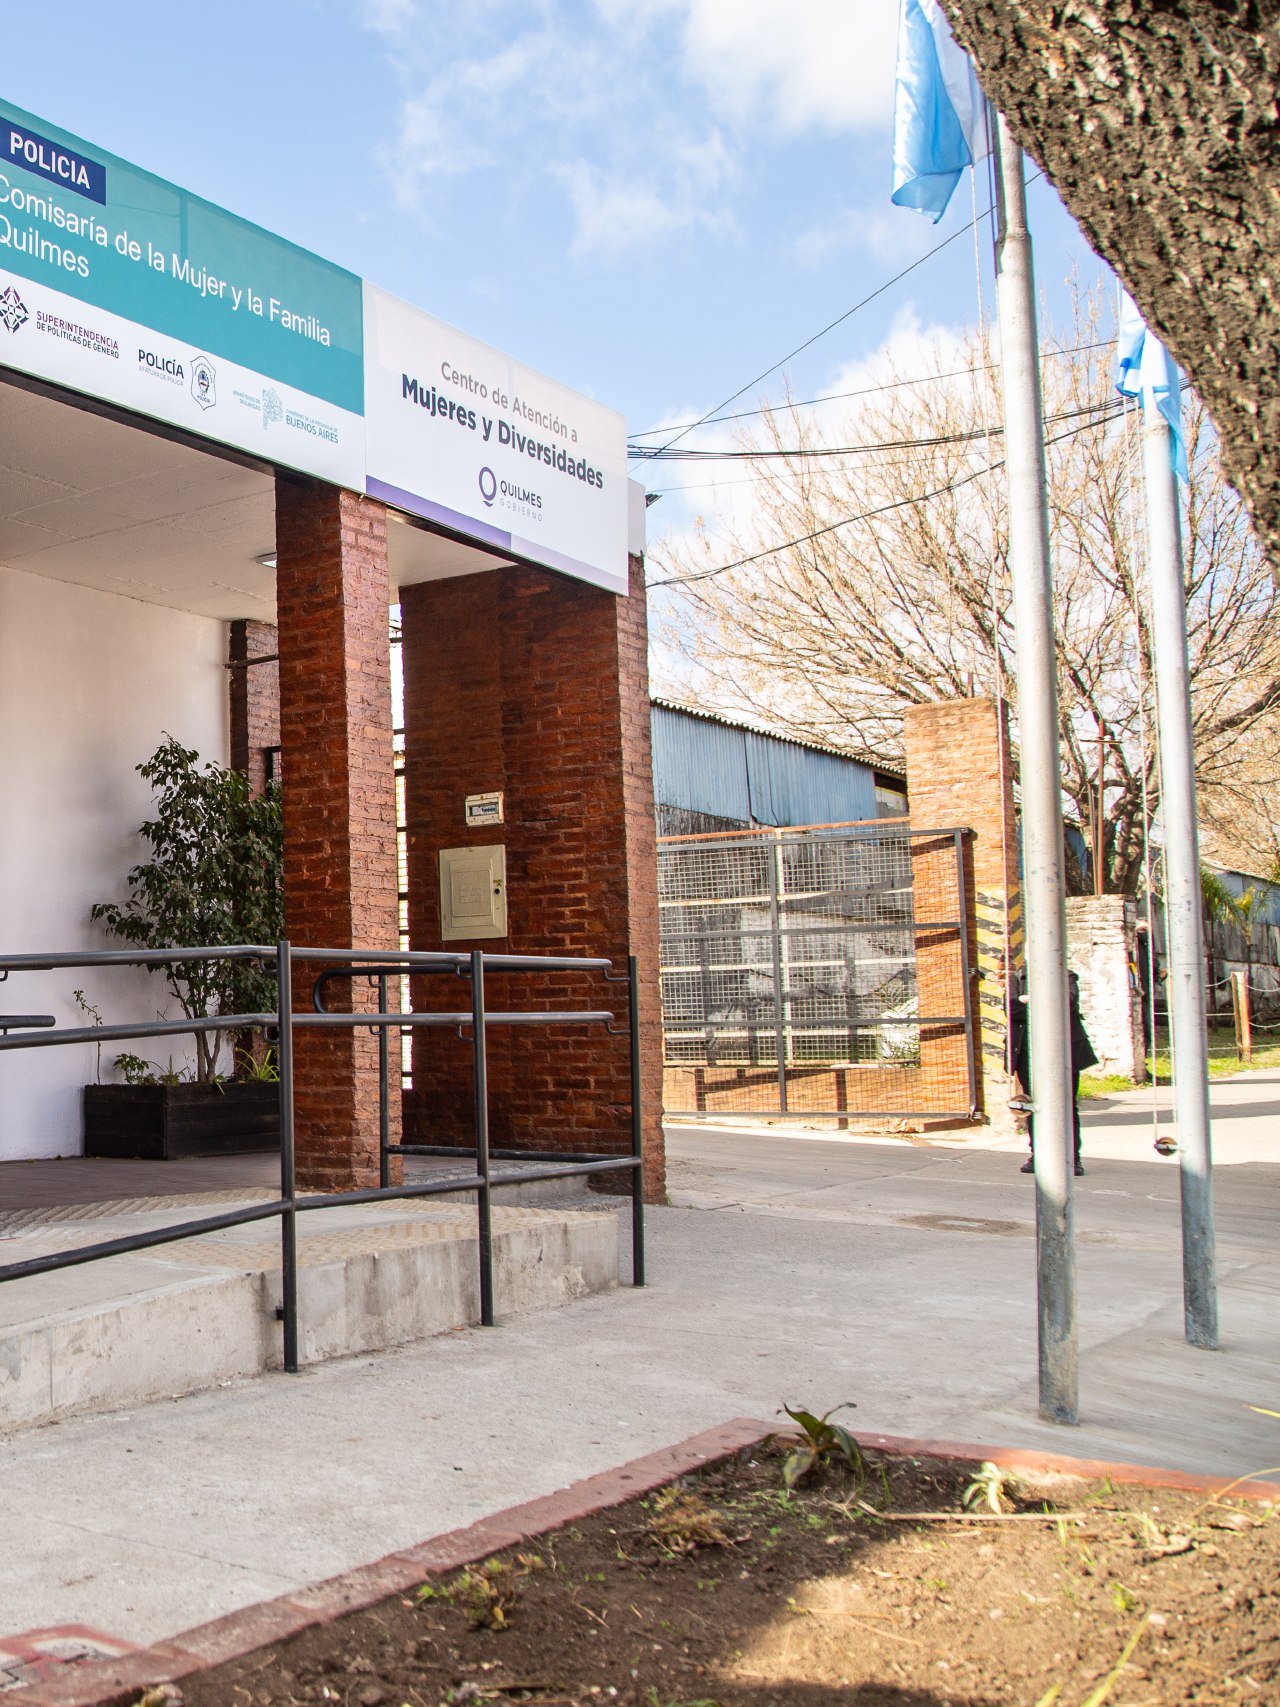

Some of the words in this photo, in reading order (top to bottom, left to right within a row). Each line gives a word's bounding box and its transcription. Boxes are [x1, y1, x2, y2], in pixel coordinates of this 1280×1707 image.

[10, 131, 91, 190] POLICIA
[114, 231, 141, 262] de
[148, 242, 165, 273] la
[172, 253, 226, 298] Mujer
[231, 285, 242, 311] y
[247, 288, 263, 317] la
[269, 297, 331, 347] Familia
[36, 310, 119, 350] SUPERINTENDENCIA
[36, 321, 46, 332] DE
[82, 338, 92, 349] DE
[138, 349, 185, 379] POLICÍA
[440, 361, 488, 399] Centro
[491, 387, 508, 410] de
[512, 396, 568, 438] Atención
[571, 427, 578, 443] a
[286, 414, 317, 435] BUENOS
[318, 428, 339, 444] AIRES
[402, 373, 476, 431] Mujeres
[481, 416, 493, 442] y
[498, 420, 604, 490] Diversidades
[500, 480, 542, 509] QUILMES
[500, 498, 543, 522] GOBIERNO
